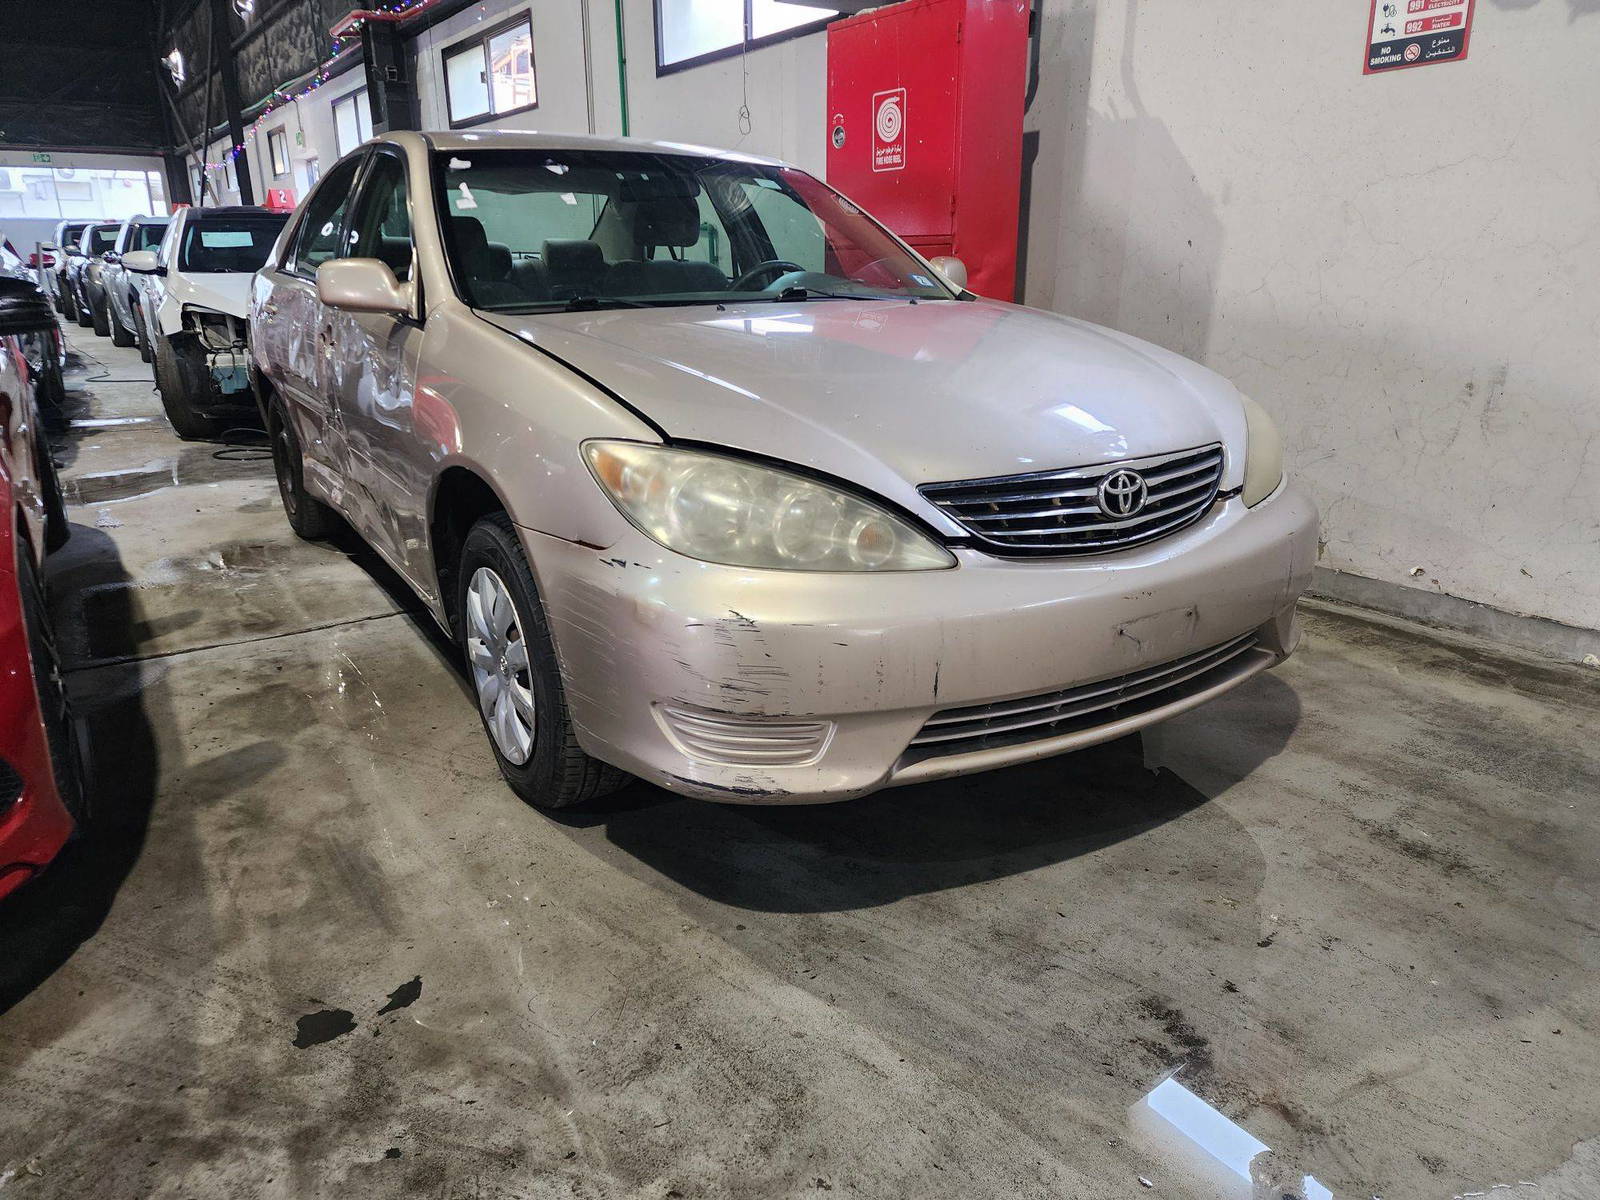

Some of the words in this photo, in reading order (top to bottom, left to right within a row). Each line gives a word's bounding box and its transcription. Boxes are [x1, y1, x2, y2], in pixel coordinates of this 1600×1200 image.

[1409, 0, 1425, 11] 991
[1406, 22, 1423, 32] 992
[1431, 37, 1450, 48] ممنوع
[1381, 47, 1391, 55] NO
[1425, 47, 1456, 58] التدخين
[1370, 55, 1402, 66] SMOKING
[280, 190, 287, 203] 2
